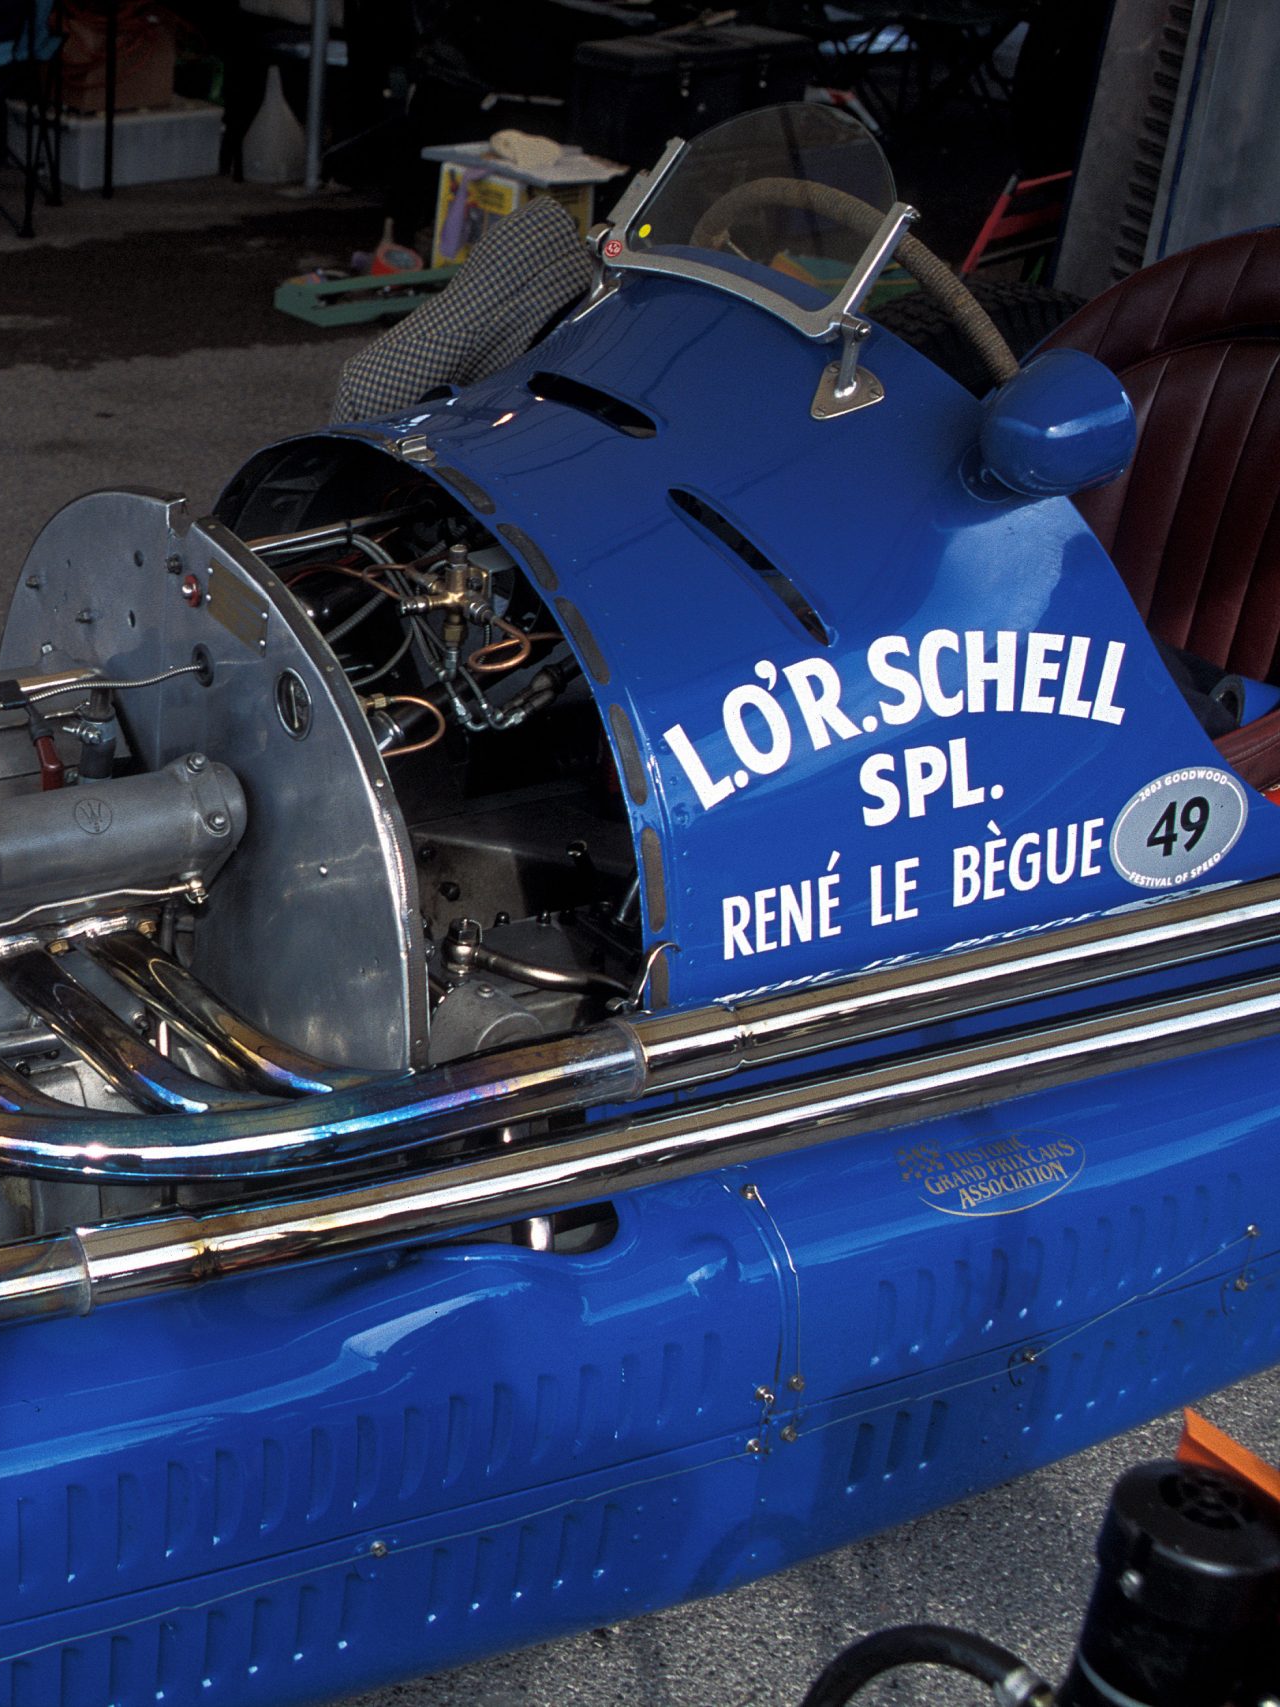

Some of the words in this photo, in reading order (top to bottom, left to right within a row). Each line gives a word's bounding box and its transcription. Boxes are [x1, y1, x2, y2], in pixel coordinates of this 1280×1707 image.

[859, 737, 1004, 827] SPL.
[1139, 781, 1162, 801] 2003
[1164, 769, 1228, 786] GOODWOOD
[1146, 796, 1210, 857] 49
[722, 850, 842, 960] RENÉ
[870, 857, 919, 927] LE
[952, 817, 1104, 908] BÈGUE
[1129, 871, 1172, 887] FESTIVAL
[1174, 872, 1189, 884] OF
[1190, 852, 1221, 879] SPEED
[924, 1163, 988, 1196] GRAND
[989, 1147, 1029, 1177] PRIX
[1028, 1138, 1076, 1165] CARS
[958, 1159, 1069, 1210] ASSOCIATION
